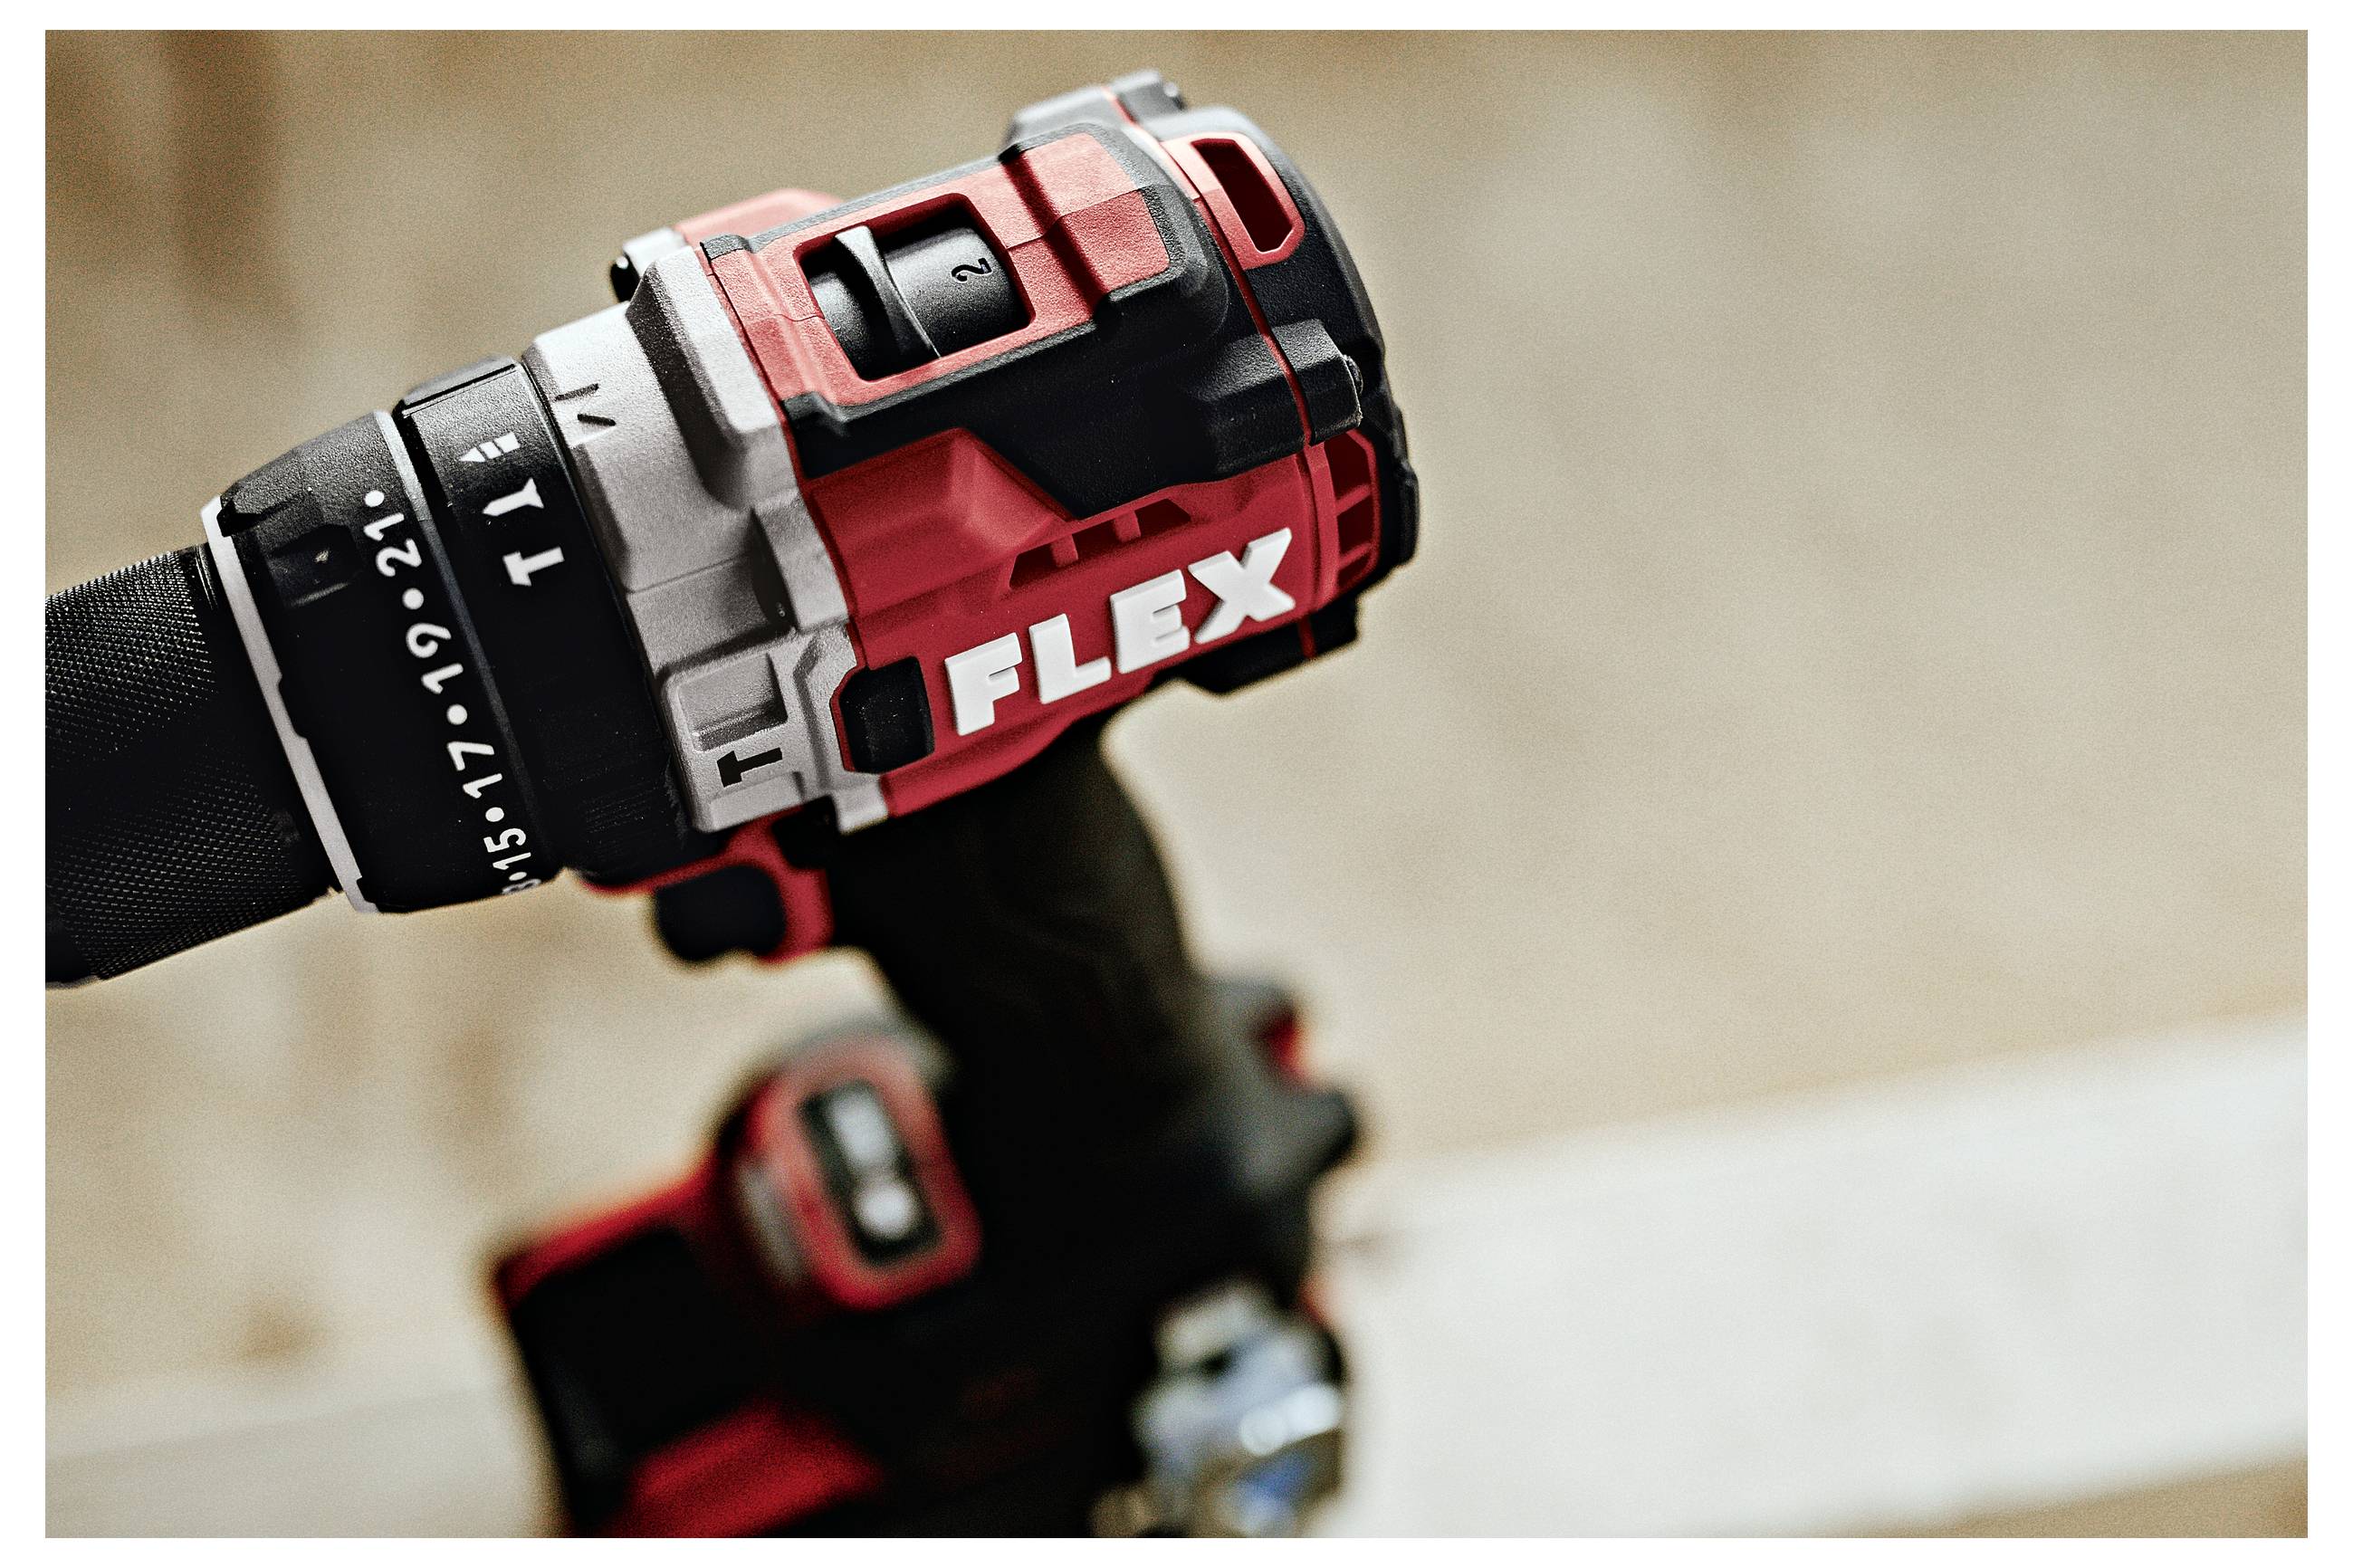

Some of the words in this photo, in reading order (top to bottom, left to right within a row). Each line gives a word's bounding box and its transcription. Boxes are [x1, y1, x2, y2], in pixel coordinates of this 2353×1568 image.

[951, 257, 992, 282] 2
[363, 512, 423, 578] 21
[406, 622, 464, 694] 19
[944, 527, 1296, 736] FLEX
[446, 741, 503, 799] 17
[483, 827, 532, 871] 15
